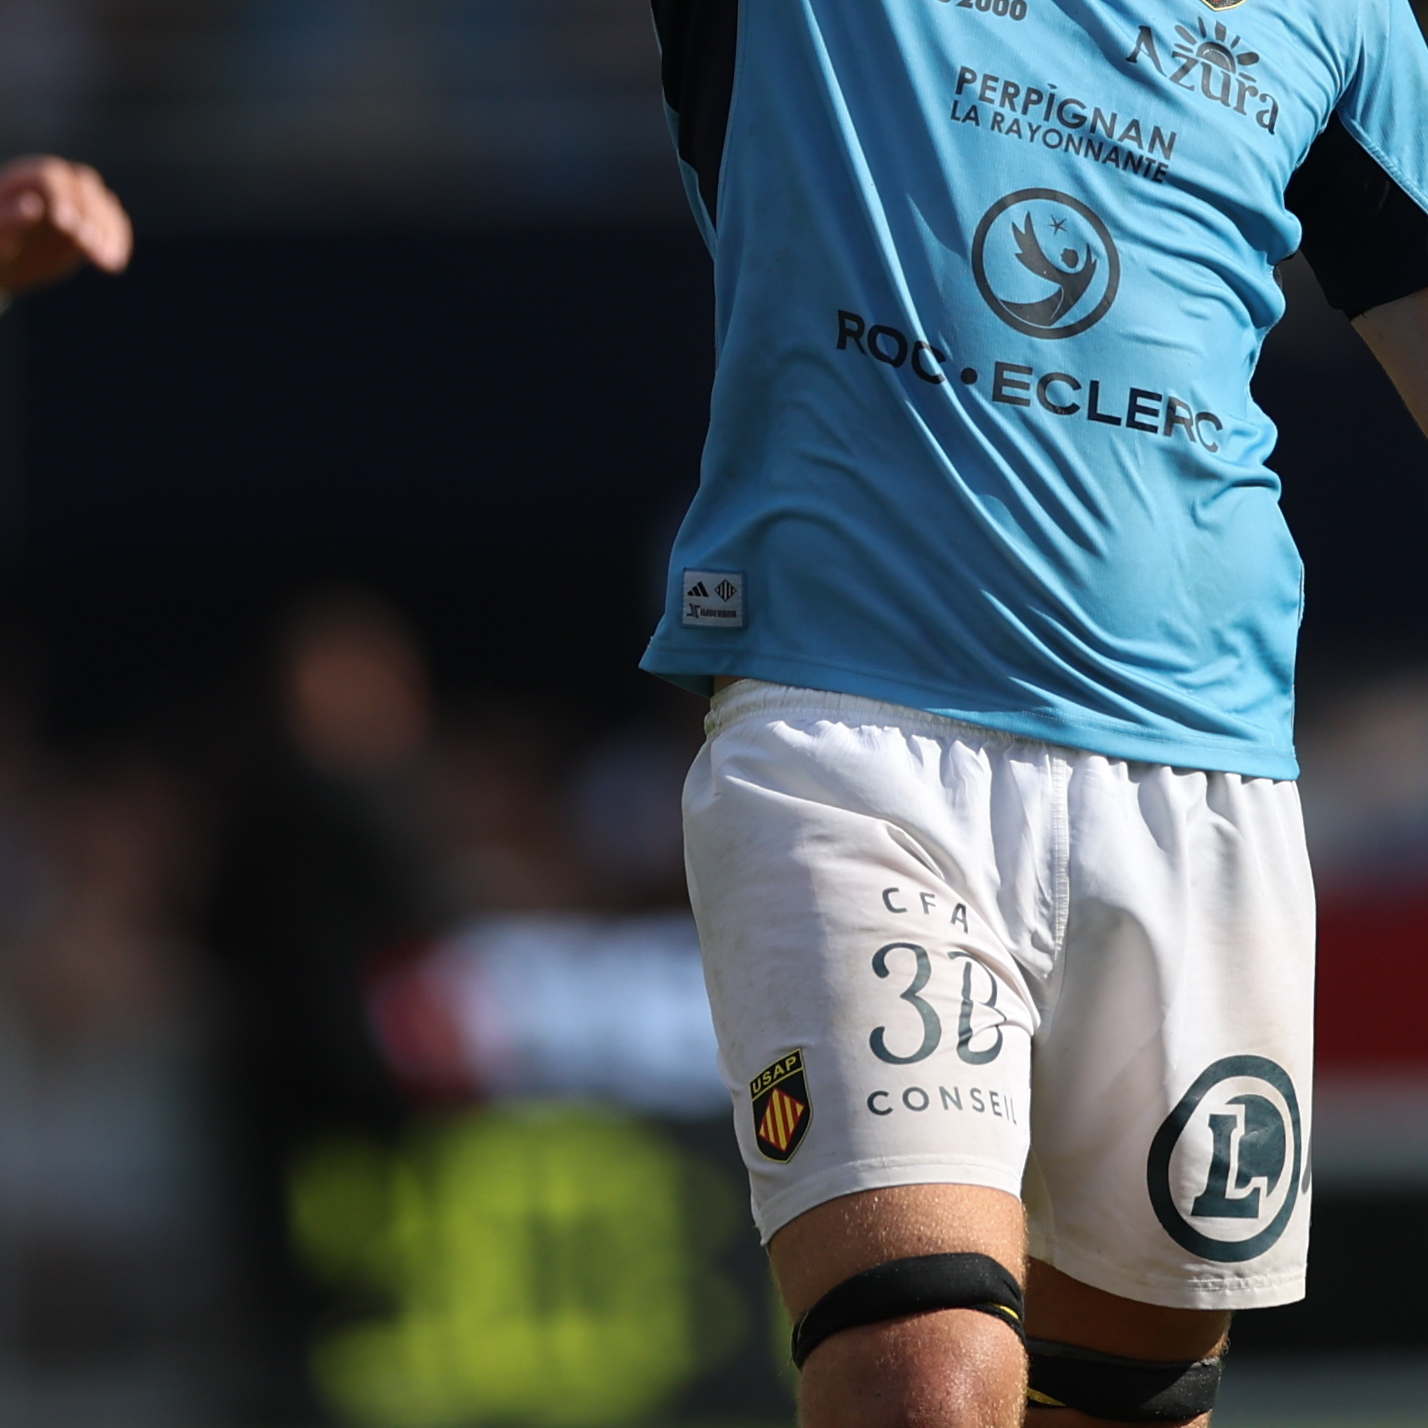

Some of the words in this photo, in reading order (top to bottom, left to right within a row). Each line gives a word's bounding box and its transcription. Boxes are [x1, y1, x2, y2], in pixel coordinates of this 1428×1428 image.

[1126, 25, 1279, 135] Azura
[950, 100, 980, 126] LA
[990, 111, 1169, 183] RAYONNANTE
[882, 886, 969, 933] CFA
[869, 942, 1007, 1065] 3B
[752, 1056, 797, 1094] USAP
[867, 1086, 1017, 1125] CONSEIL
